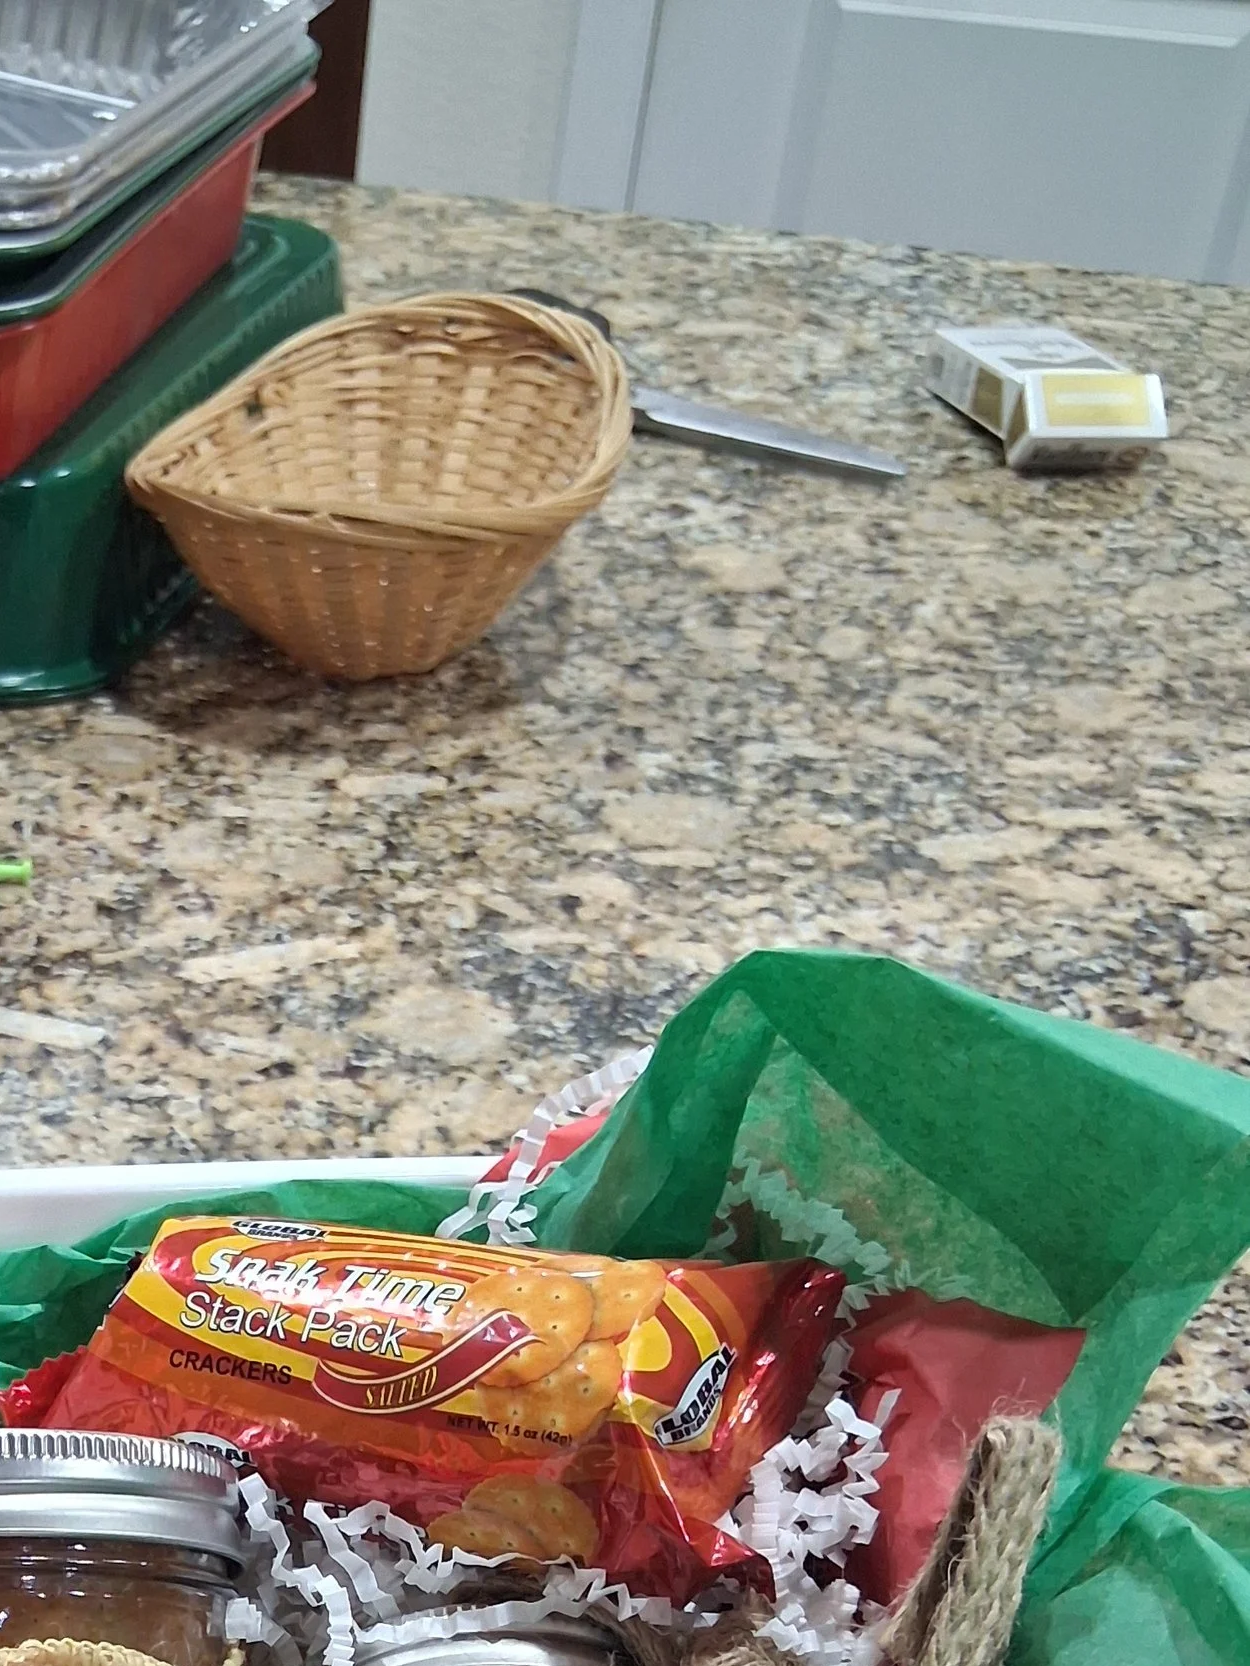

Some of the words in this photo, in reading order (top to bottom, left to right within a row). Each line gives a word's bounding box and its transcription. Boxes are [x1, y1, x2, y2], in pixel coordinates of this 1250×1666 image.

[232, 1220, 327, 1238] GLOBAL
[195, 1248, 328, 1298] Snak
[330, 1264, 467, 1317] Time
[179, 1291, 294, 1341] Stack
[300, 1306, 409, 1358] Pack
[168, 1348, 293, 1386] CRACKERS
[365, 1365, 438, 1409] SALTED
[447, 1416, 474, 1430] NET
[477, 1418, 501, 1433] WT.
[503, 1424, 521, 1438] 1.5
[523, 1430, 538, 1440] oz
[540, 1428, 573, 1447] (42g)
